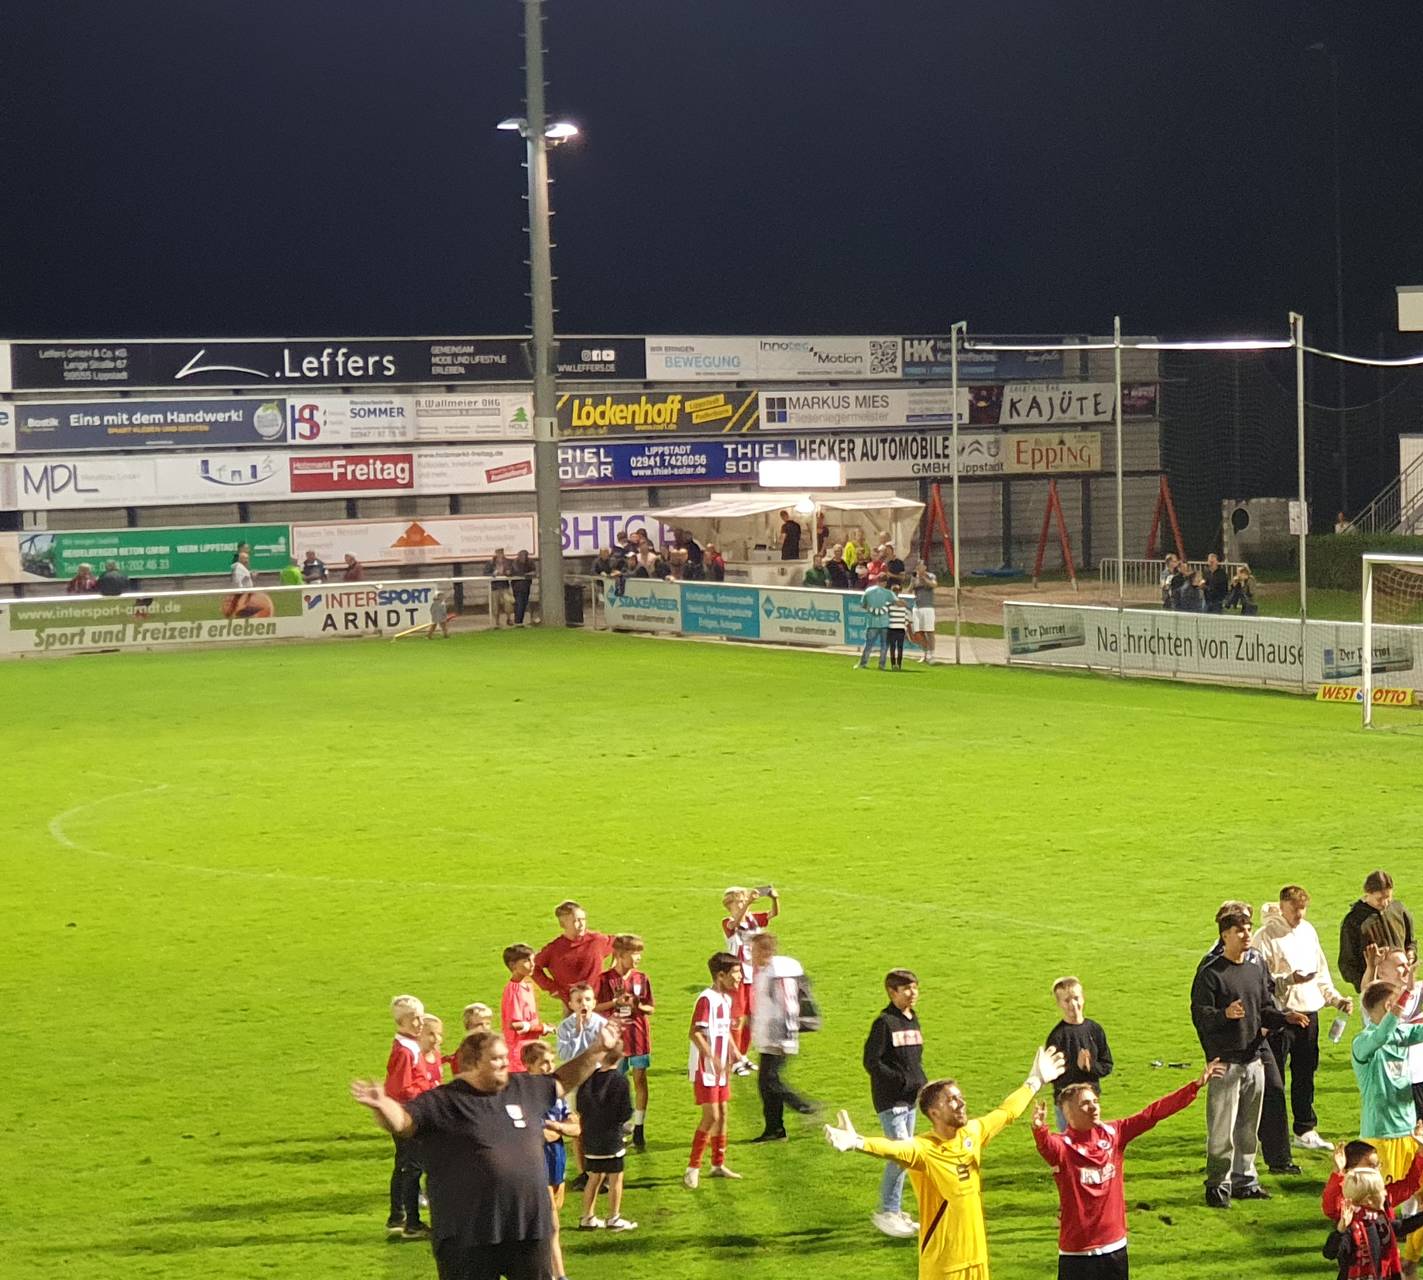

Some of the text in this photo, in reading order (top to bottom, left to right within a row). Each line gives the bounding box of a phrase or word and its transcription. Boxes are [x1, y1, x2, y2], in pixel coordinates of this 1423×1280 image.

[664, 355, 741, 369] BEWEGUNG
[817, 353, 864, 365] Motion
[789, 395, 889, 410] MARKUS MIES
[1008, 391, 1107, 422] KAJÜTE
[69, 409, 244, 427] Eins mit dem Handwerk!
[350, 407, 406, 419] SOMMER
[572, 395, 682, 427] Löckenhoff
[558, 448, 613, 464] HIEL
[645, 446, 691, 456] LIPPSTADT
[723, 444, 791, 459] THIEL
[799, 436, 950, 462] HECKER AUTOMOBILE
[630, 456, 661, 467] 02941
[911, 463, 950, 474] GMBH
[332, 459, 410, 484] Freitag
[558, 466, 613, 480] OLAR
[325, 587, 431, 609] INTERSPORT
[17, 601, 181, 620] www.intersport-arndt.de
[322, 608, 419, 632] ARNDT
[34, 617, 277, 650] Sport und Freizeit erleben
[1199, 638, 1229, 660] von
[1234, 633, 1304, 666] Zuhause
[1322, 686, 1357, 700] WEST
